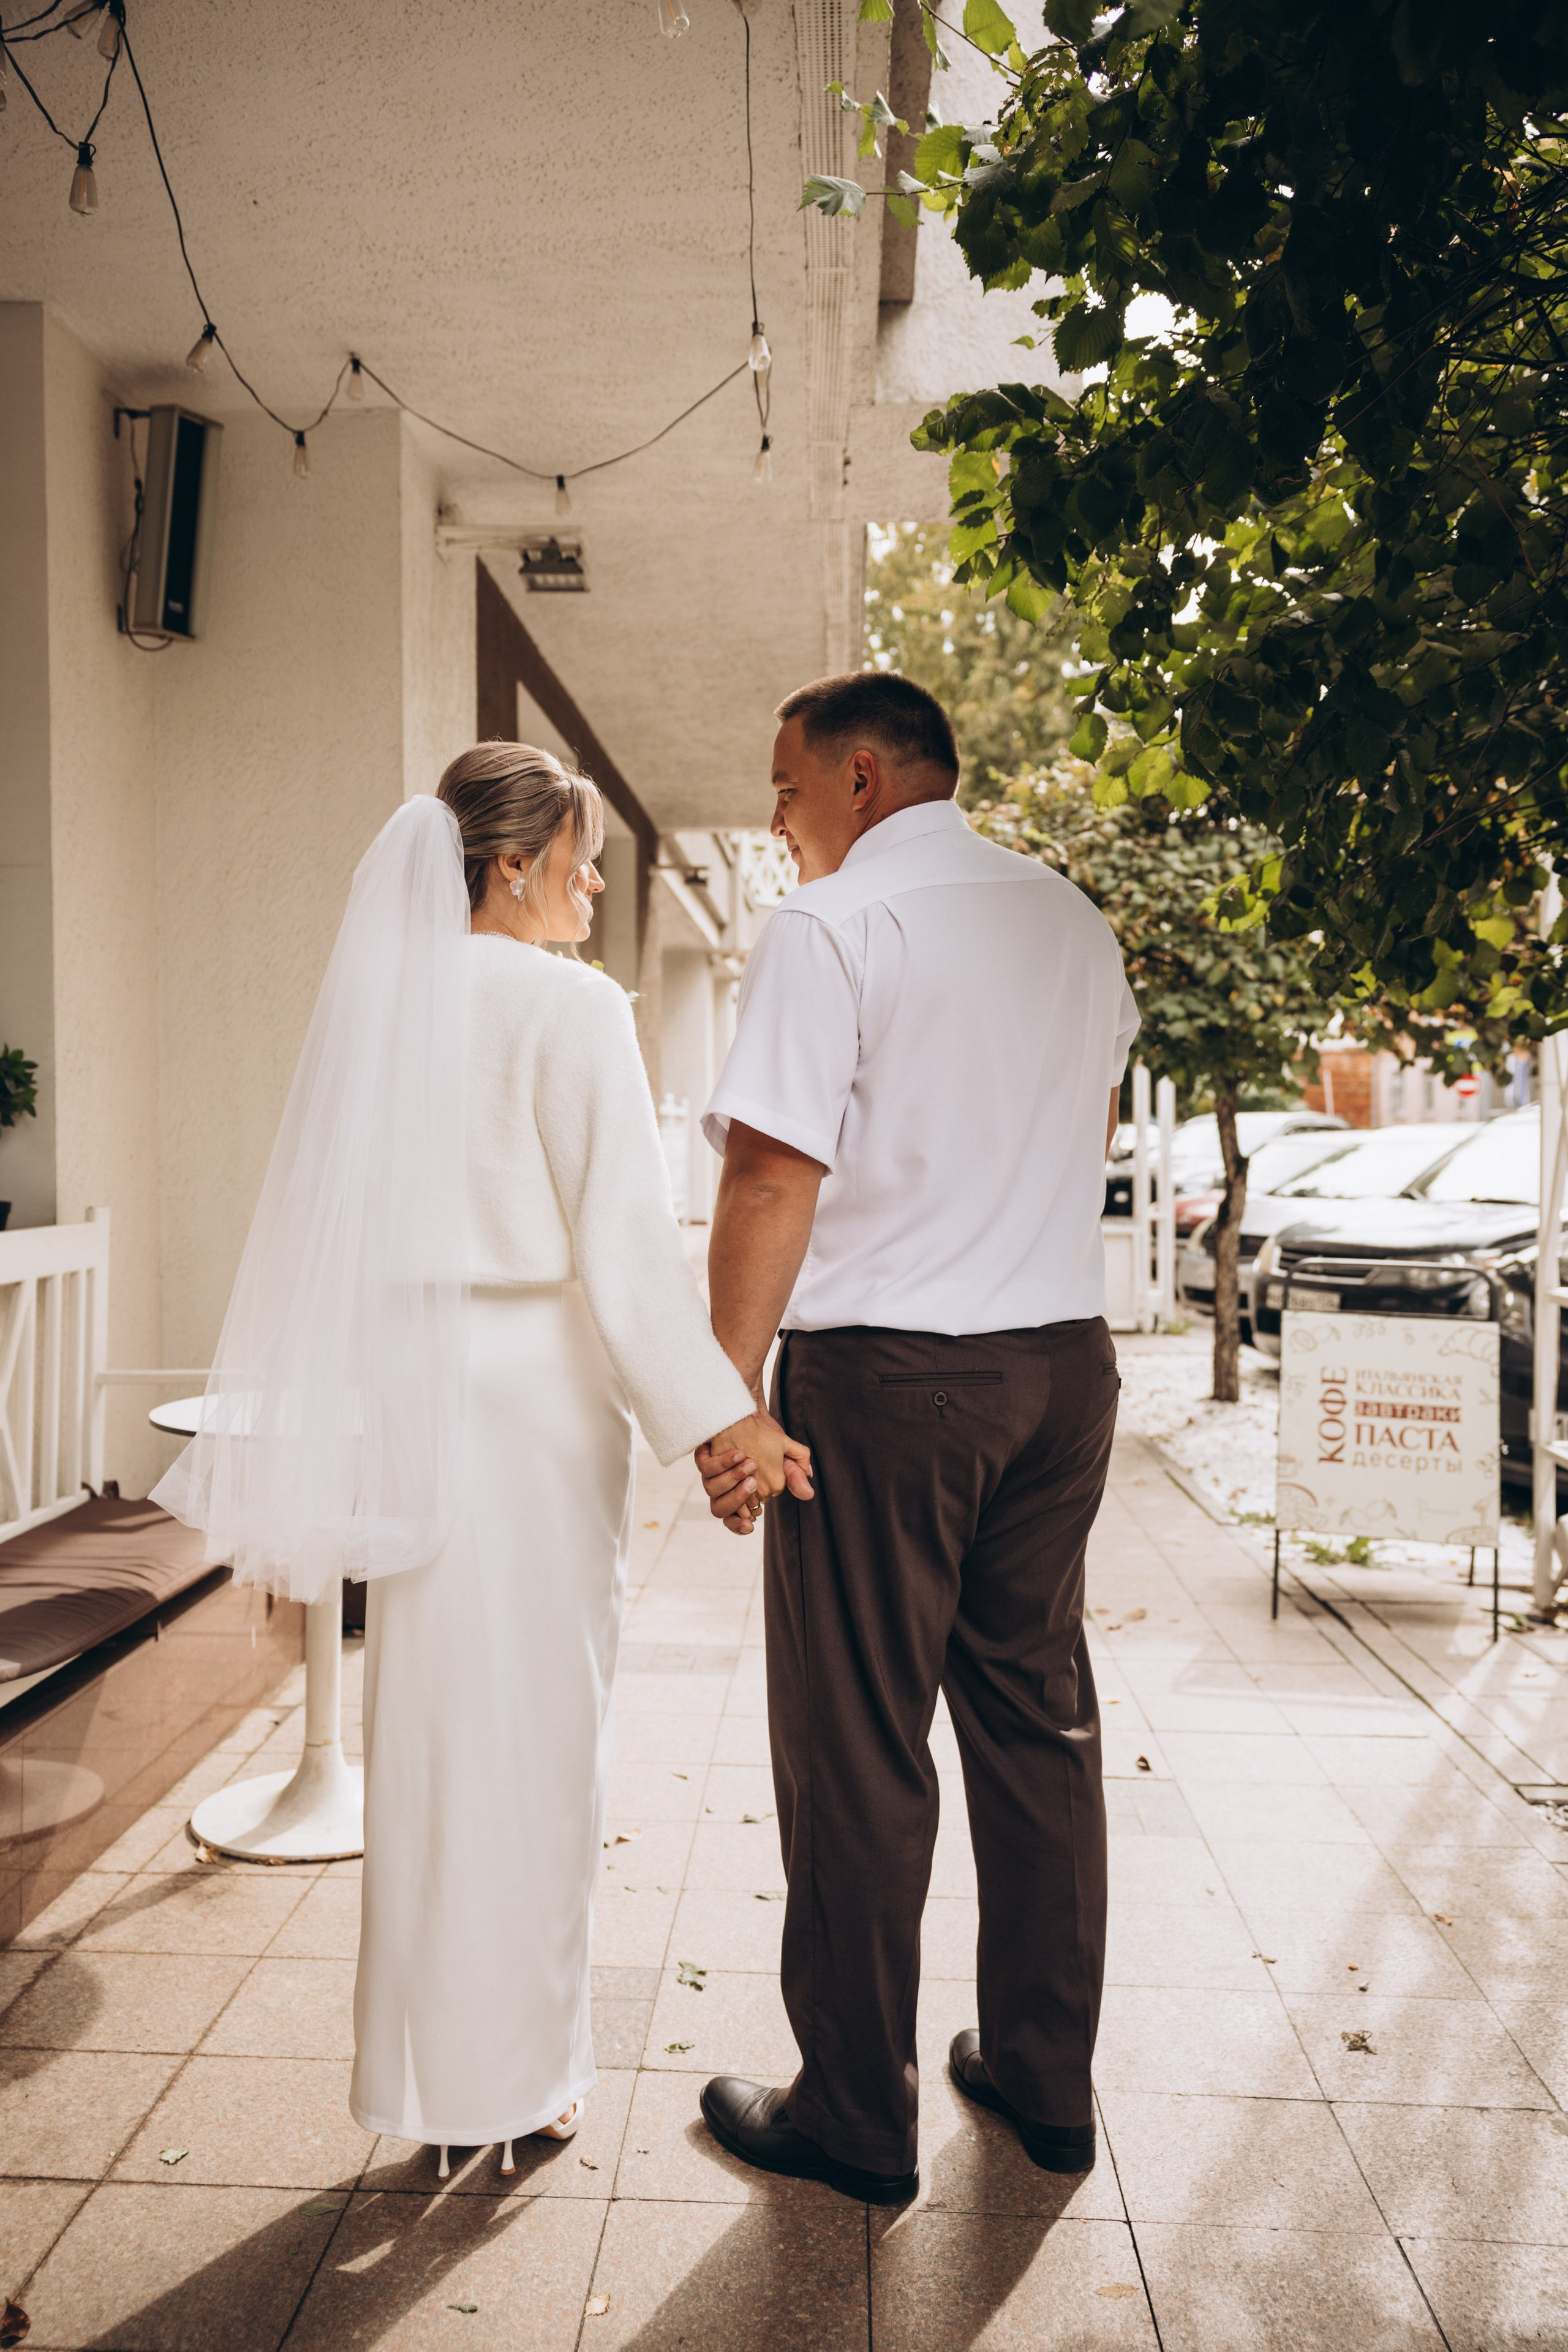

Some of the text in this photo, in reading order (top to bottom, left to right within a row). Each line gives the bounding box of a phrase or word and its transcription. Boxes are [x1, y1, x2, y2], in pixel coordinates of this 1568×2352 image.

[1355, 1369, 1462, 1385] ИТАЛЬЯНСКАЯ
[1355, 1382, 1461, 1400] КЛАССИКА
[1319, 1366, 1347, 1463] КОФЕ
[1355, 1401, 1461, 1422] завтраки
[1355, 1423, 1460, 1453] ПАСТА
[1352, 1451, 1463, 1475] десерты
